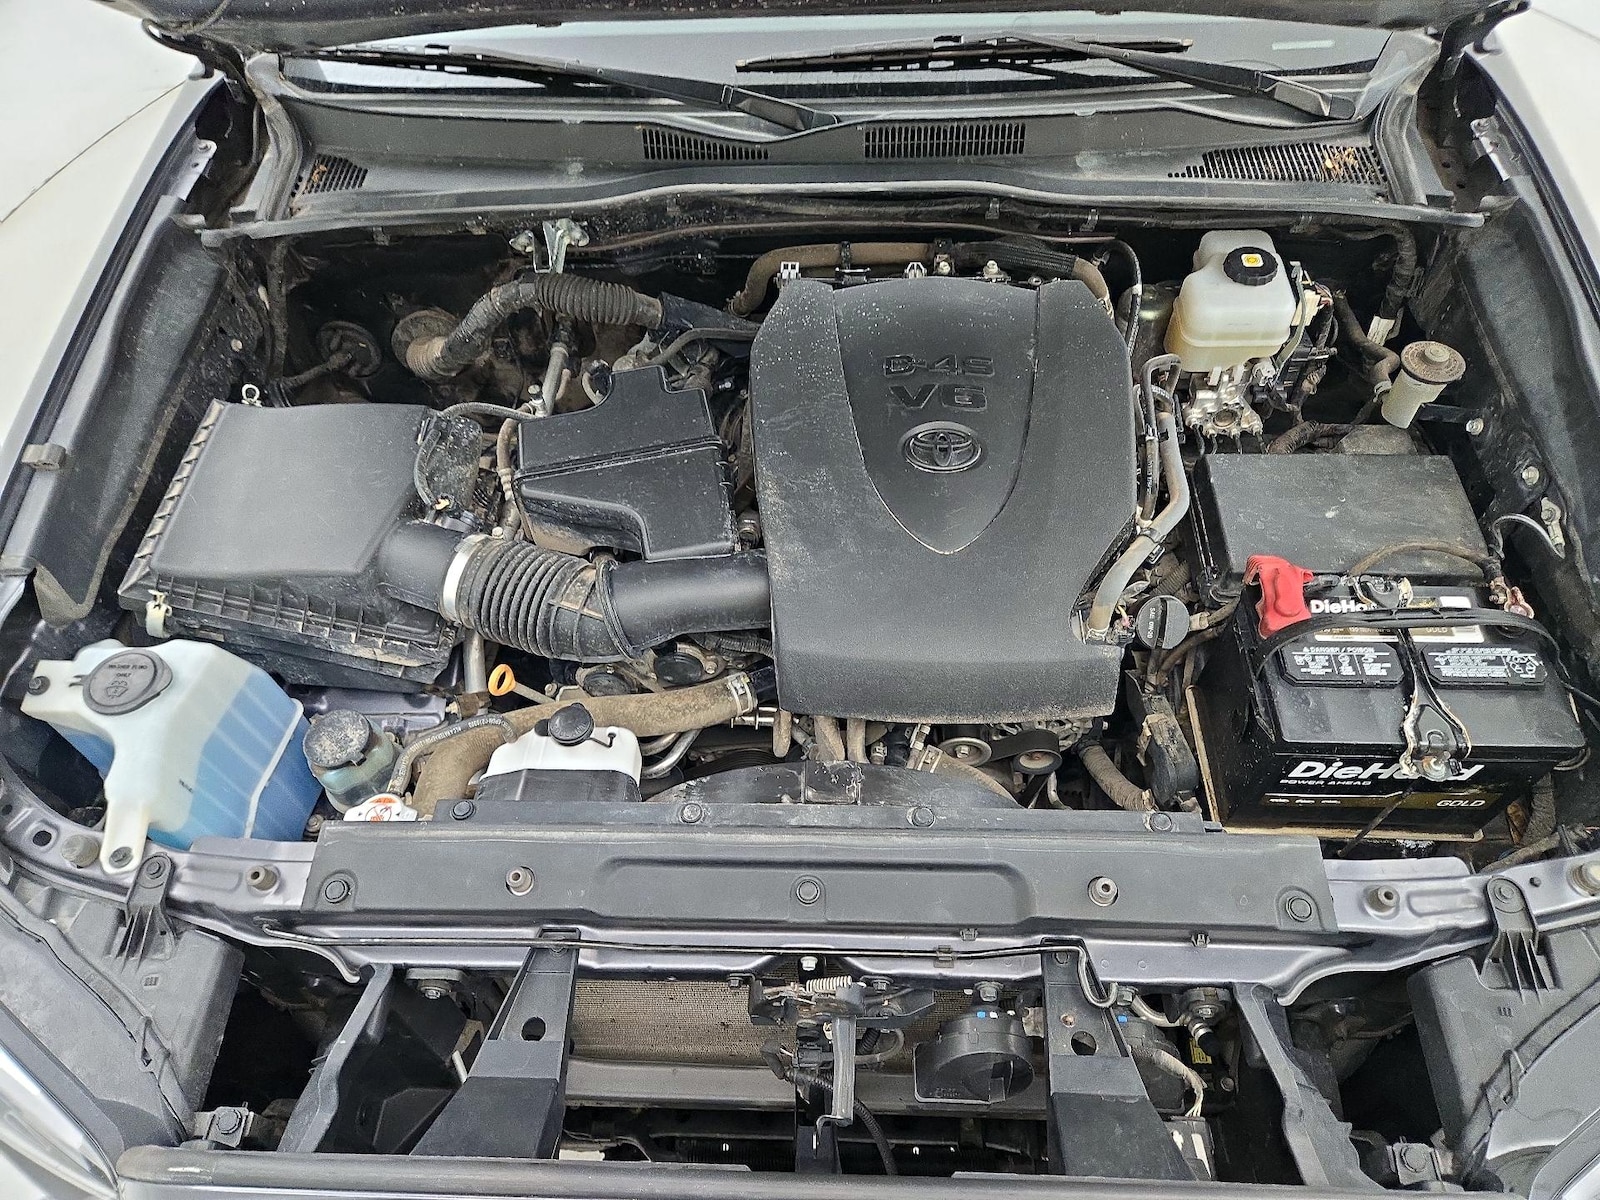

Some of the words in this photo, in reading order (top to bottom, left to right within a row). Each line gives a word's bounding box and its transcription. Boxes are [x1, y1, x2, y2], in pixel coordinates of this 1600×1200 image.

[882, 354, 995, 377] D-4S
[889, 383, 988, 411] V6
[1437, 799, 1486, 807] GOLD
